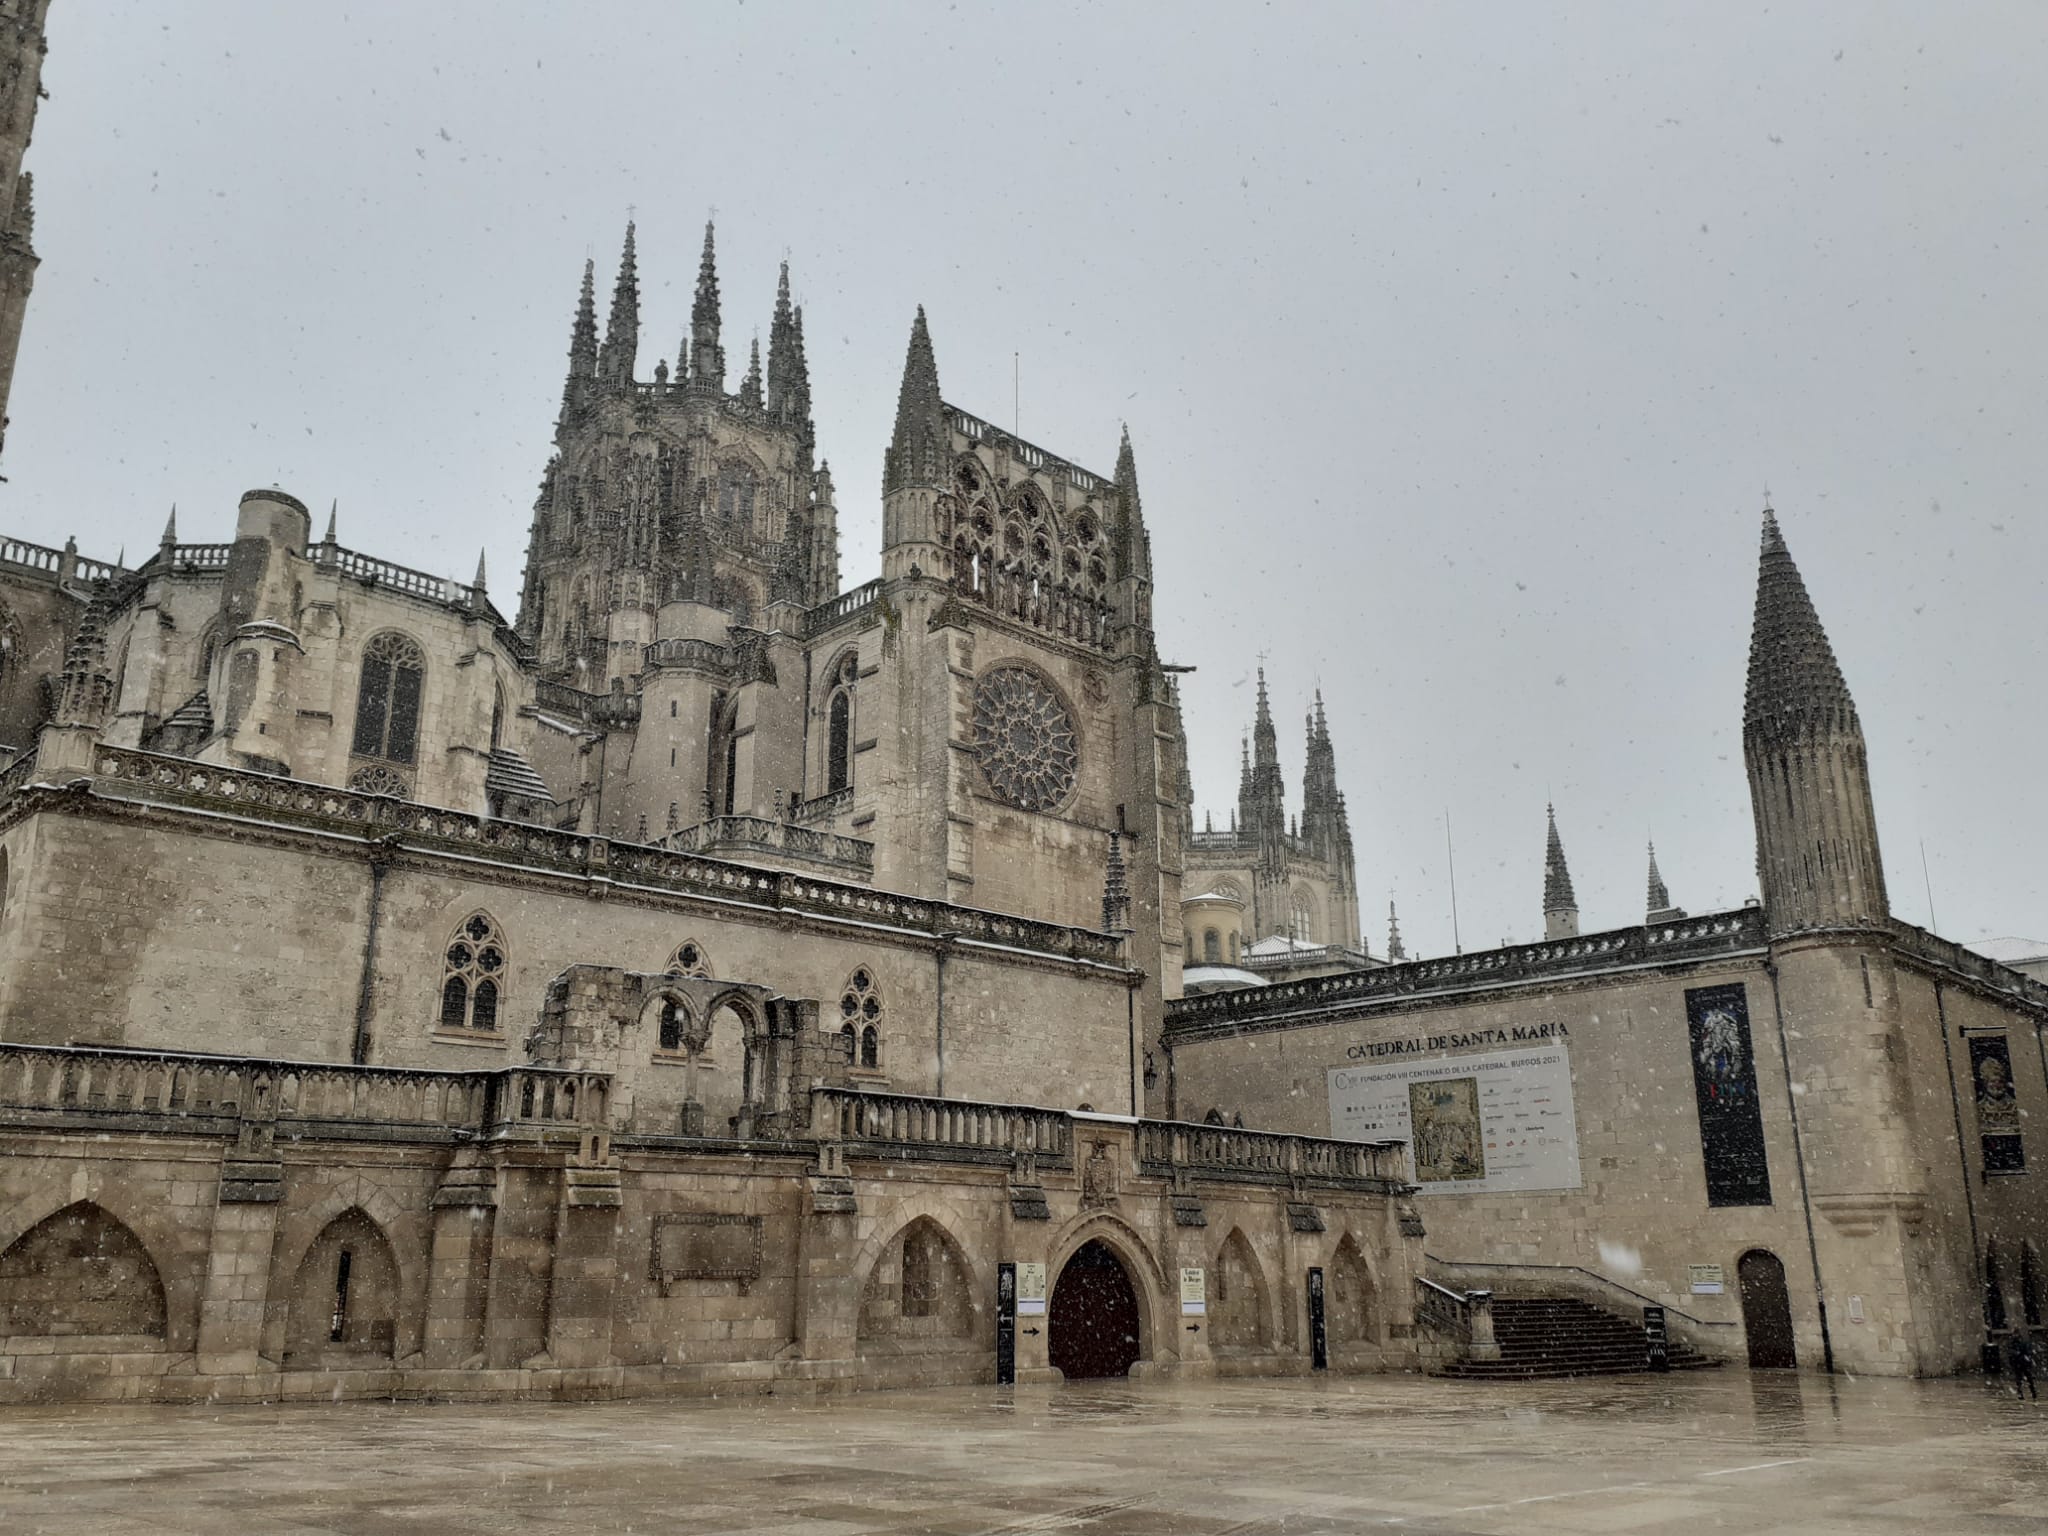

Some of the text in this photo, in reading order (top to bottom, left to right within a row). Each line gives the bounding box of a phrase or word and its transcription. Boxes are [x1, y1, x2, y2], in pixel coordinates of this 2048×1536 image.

[1347, 1039, 1424, 1059] CATEDRAL
[1428, 1035, 1447, 1050] DE
[1451, 1030, 1508, 1048] SANTA
[1398, 1072, 1408, 1081] VIII
[1409, 1066, 1451, 1079] CENTENARO
[1452, 1067, 1461, 1075] DE
[1462, 1065, 1470, 1073] LA
[1543, 1055, 1561, 1065] 2021
